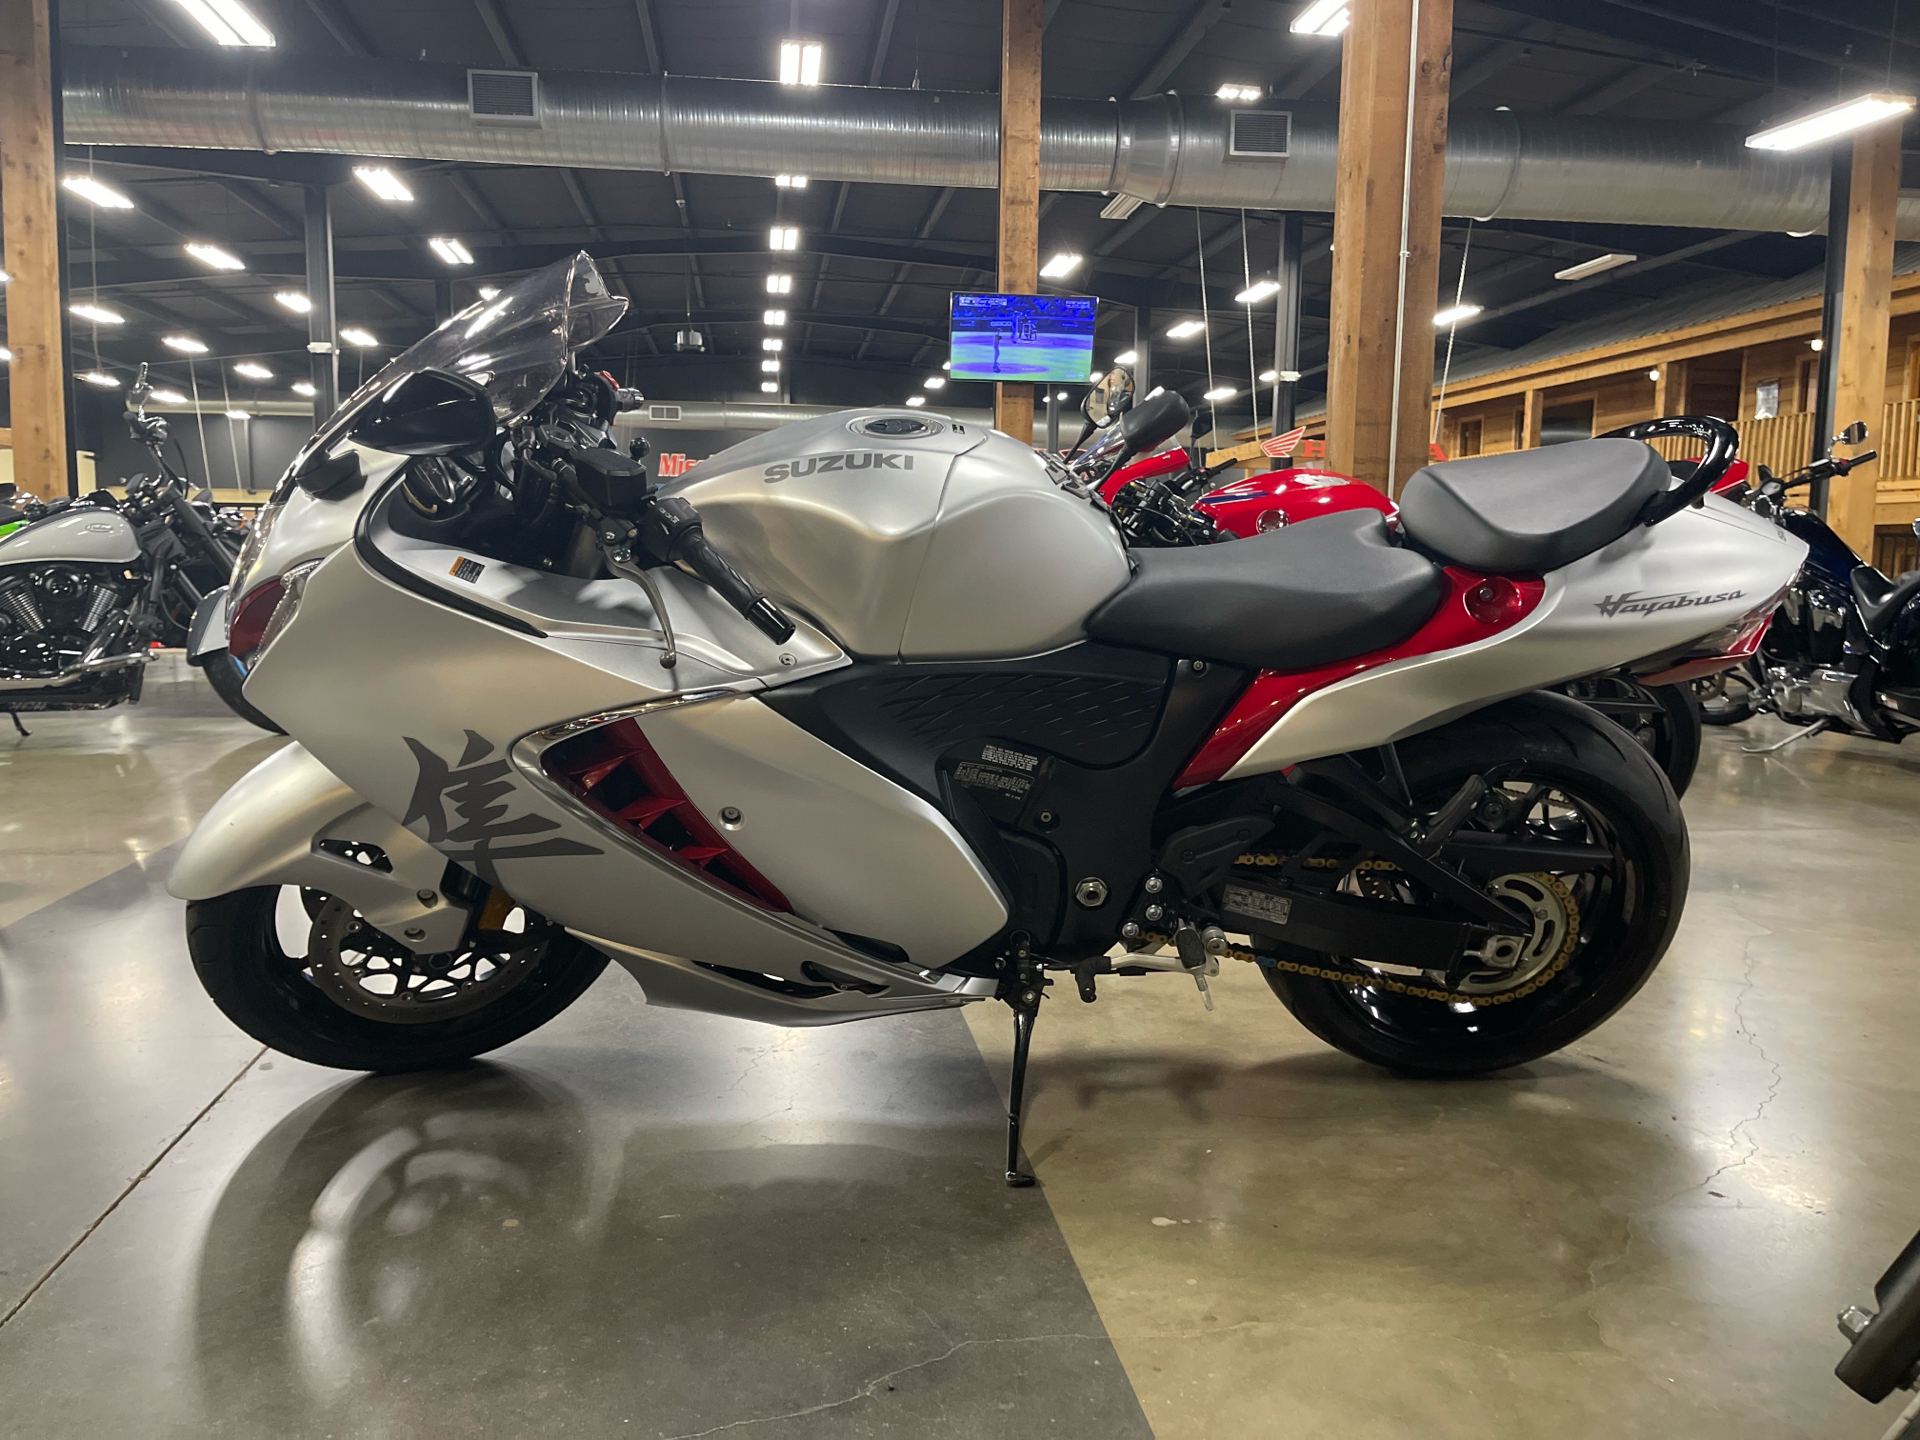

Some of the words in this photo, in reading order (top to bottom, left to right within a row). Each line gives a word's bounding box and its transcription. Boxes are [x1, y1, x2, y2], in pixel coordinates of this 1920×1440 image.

[764, 453, 914, 484] SUZUKI
[1593, 589, 1748, 618] Hayabusa
[401, 728, 606, 886] 隼
